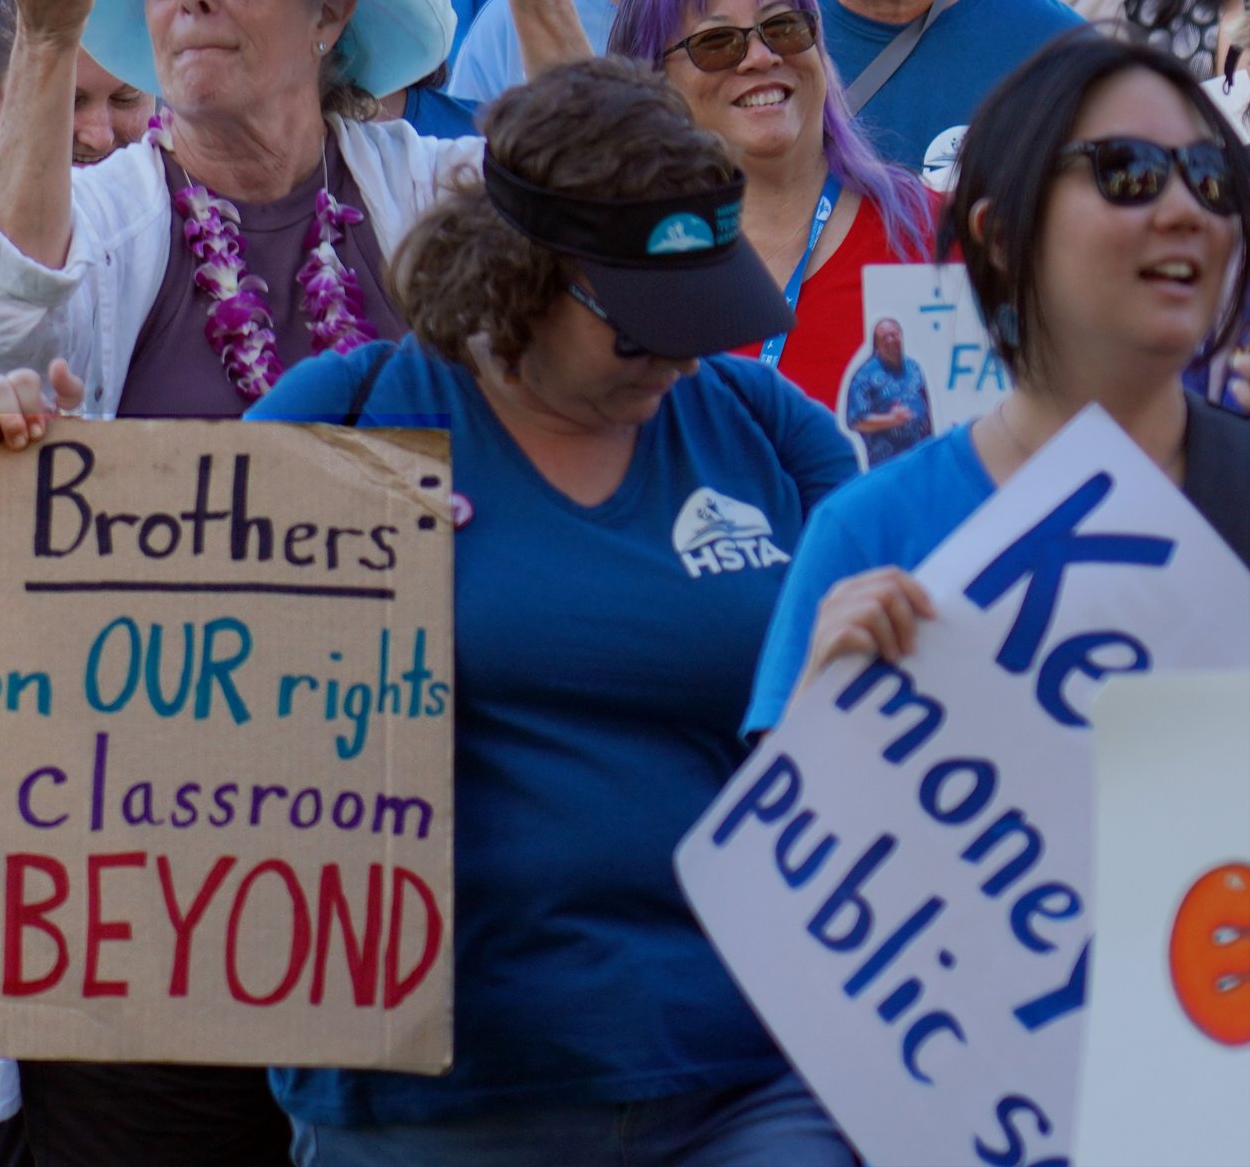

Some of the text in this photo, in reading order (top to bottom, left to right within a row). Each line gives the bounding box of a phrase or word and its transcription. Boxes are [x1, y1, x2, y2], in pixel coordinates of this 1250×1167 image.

[32, 440, 442, 571] Brothers:
[682, 536, 791, 578] HSTA
[84, 616, 254, 725] OUR
[278, 627, 450, 760] rights
[18, 732, 434, 838] classroom
[2, 851, 444, 1010] BEYOND
[711, 752, 967, 1085] public
